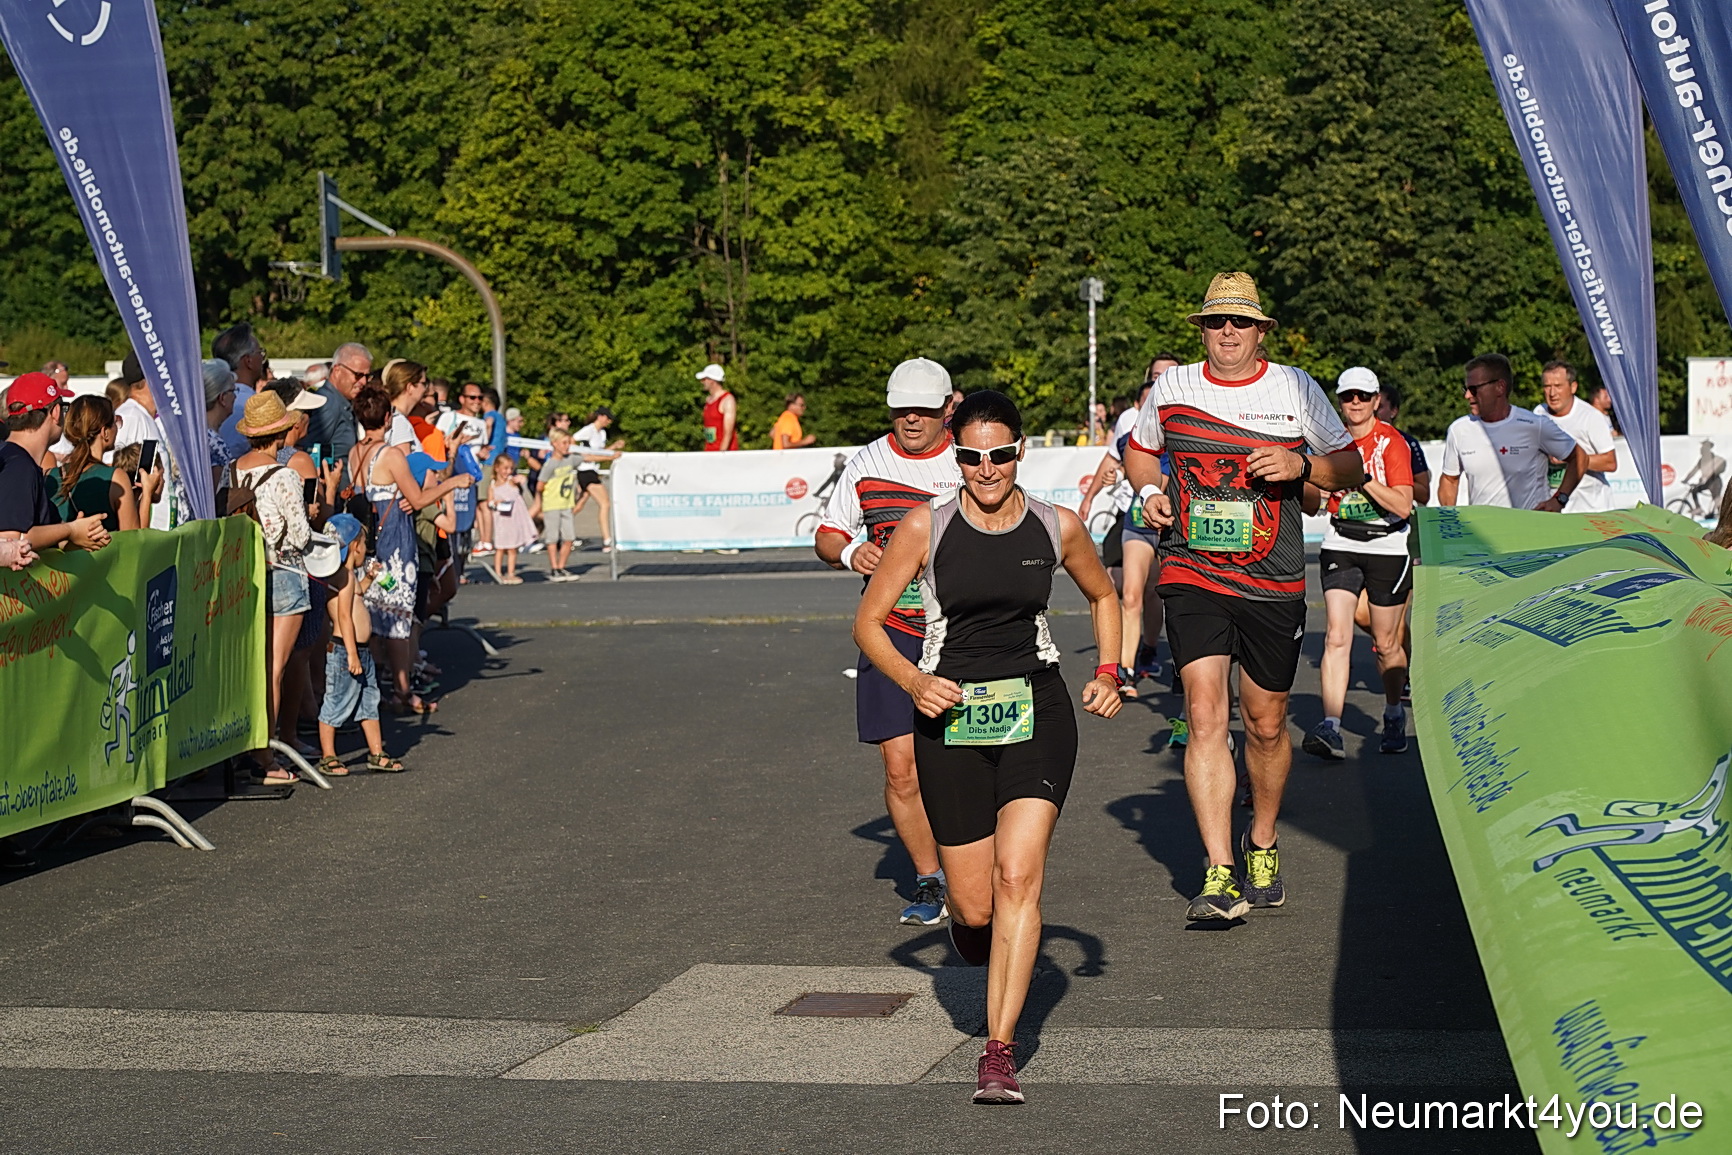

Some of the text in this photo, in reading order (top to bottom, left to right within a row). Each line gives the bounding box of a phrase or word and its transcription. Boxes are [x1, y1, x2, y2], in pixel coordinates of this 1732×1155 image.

[1238, 413, 1287, 421] NEUMARKT
[560, 478, 574, 500] 6
[635, 473, 671, 486] NOW
[1346, 502, 1375, 516] 112
[1203, 518, 1236, 535] 153
[1242, 521, 1250, 545] 2022
[1197, 534, 1222, 542] Haberler
[950, 710, 959, 733] RUN
[962, 701, 1020, 726] 1304
[1020, 703, 1030, 733] 2022
[968, 724, 1012, 735] Dibs Nadja
[1553, 867, 1659, 942] neumarkt
